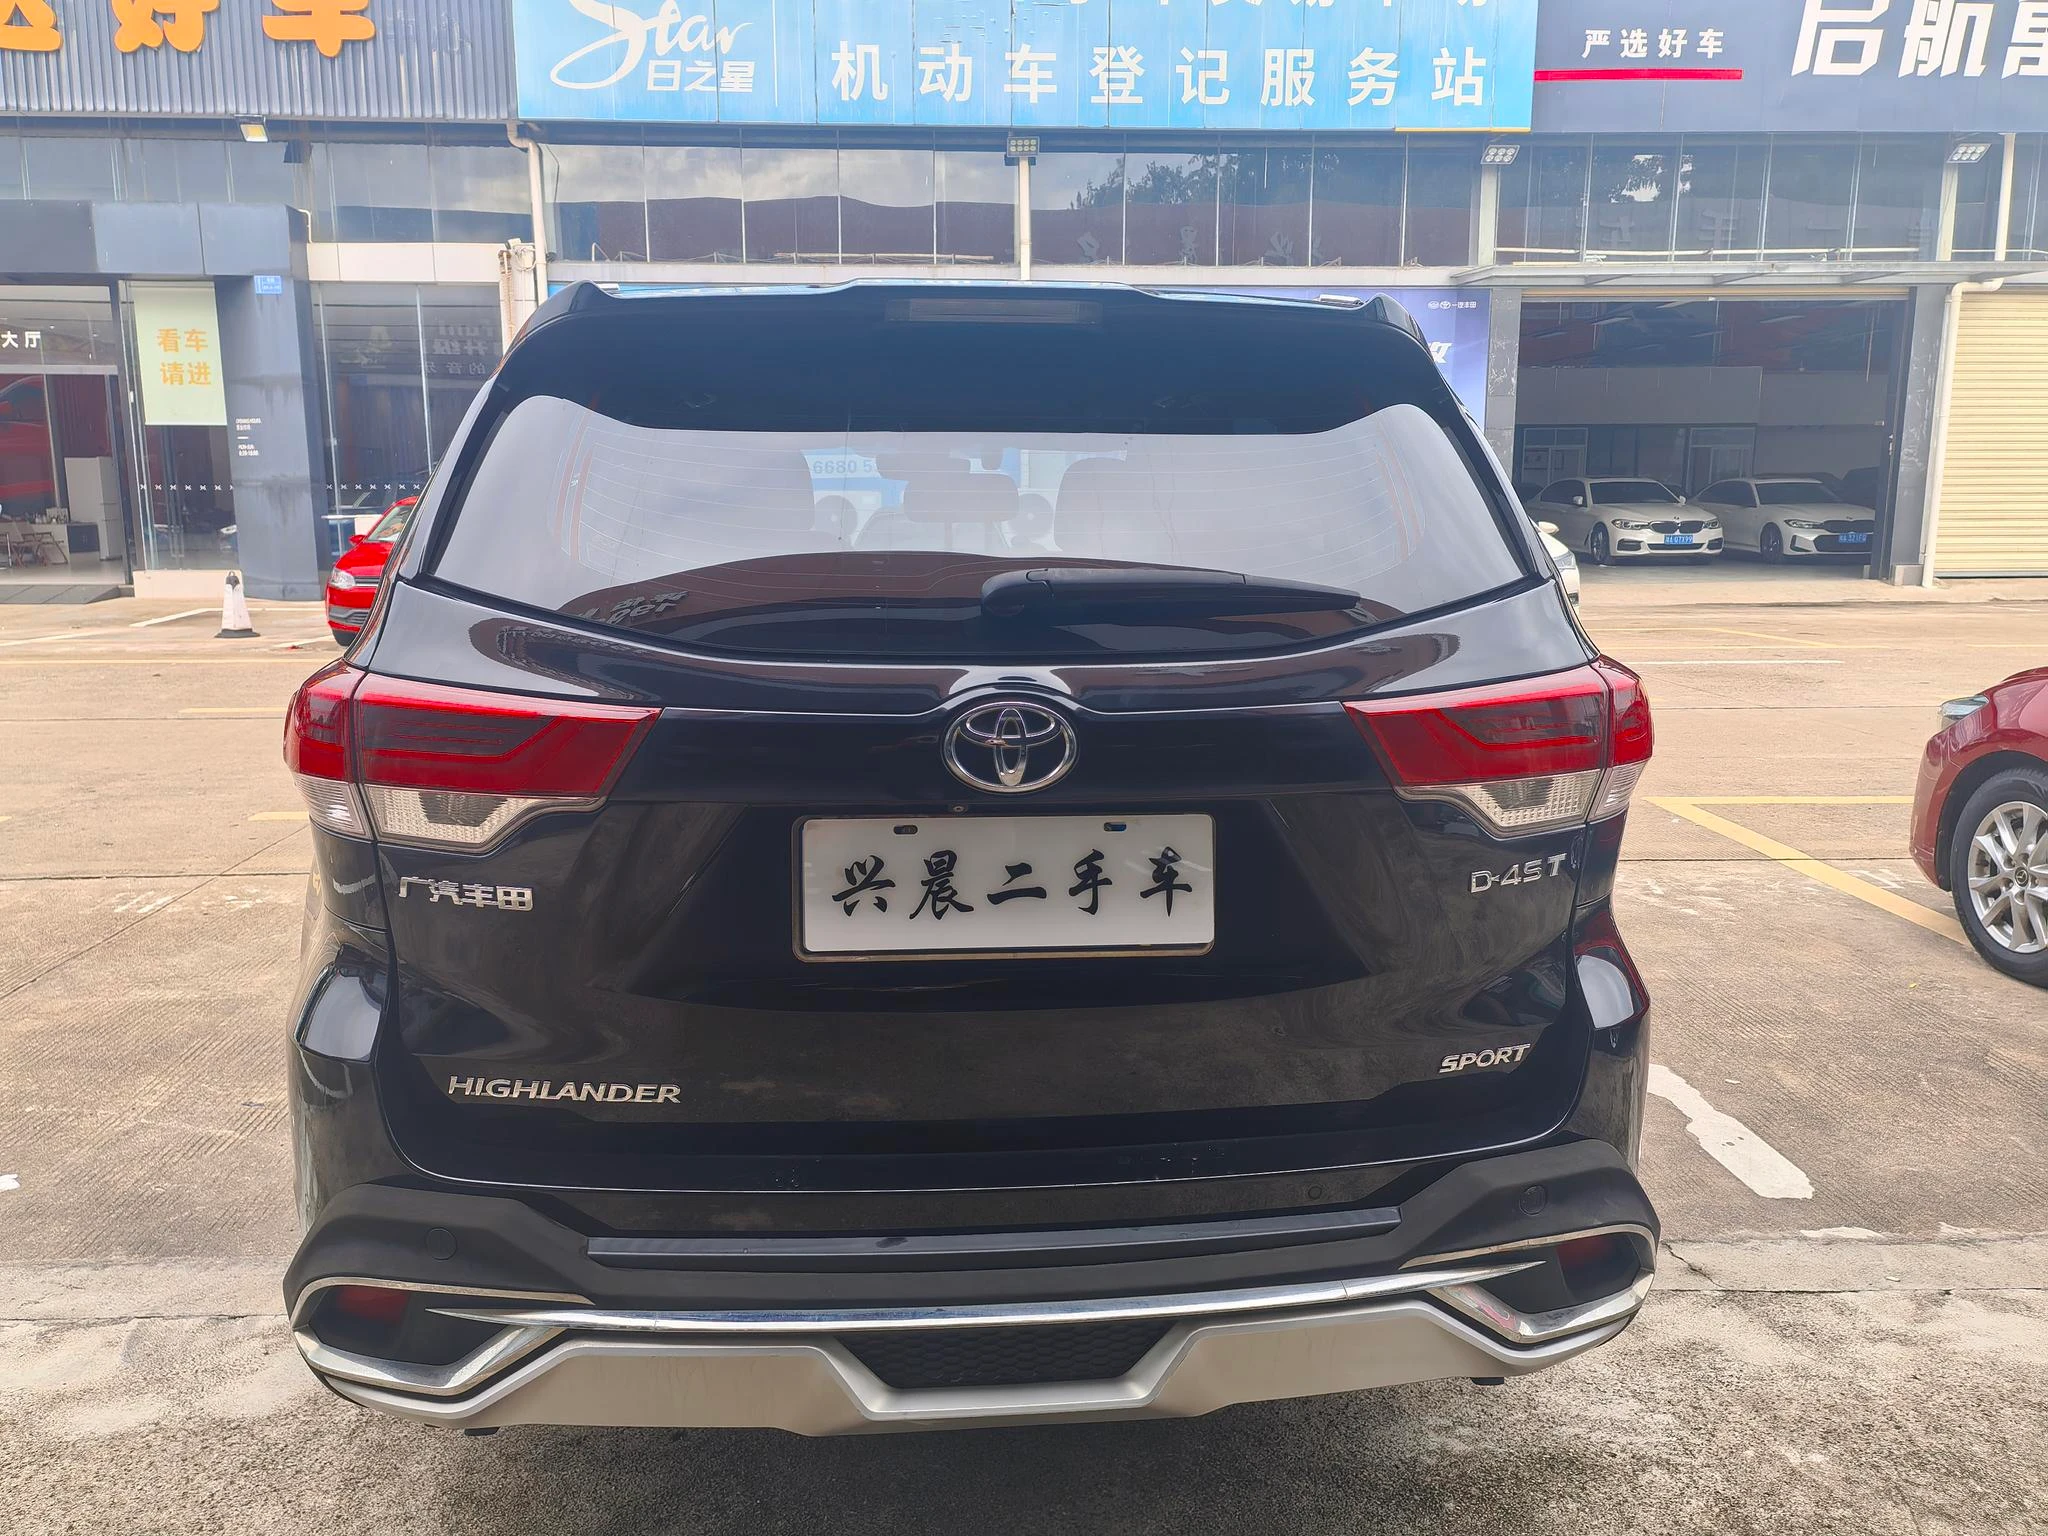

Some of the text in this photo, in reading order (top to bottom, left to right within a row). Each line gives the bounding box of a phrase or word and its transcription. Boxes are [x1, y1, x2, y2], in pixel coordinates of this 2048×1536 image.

[1581, 28, 1725, 58] 严选好车
[646, 60, 756, 93] 日之星
[831, 40, 1487, 106] 机动车登记服务站
[157, 328, 208, 353] 看车
[160, 361, 211, 386] 请进
[814, 460, 857, 474] 6680
[832, 846, 1193, 920] 兴晨二手车
[1439, 1043, 1531, 1074] SPORT
[448, 1075, 682, 1104] HIGHLANDER
